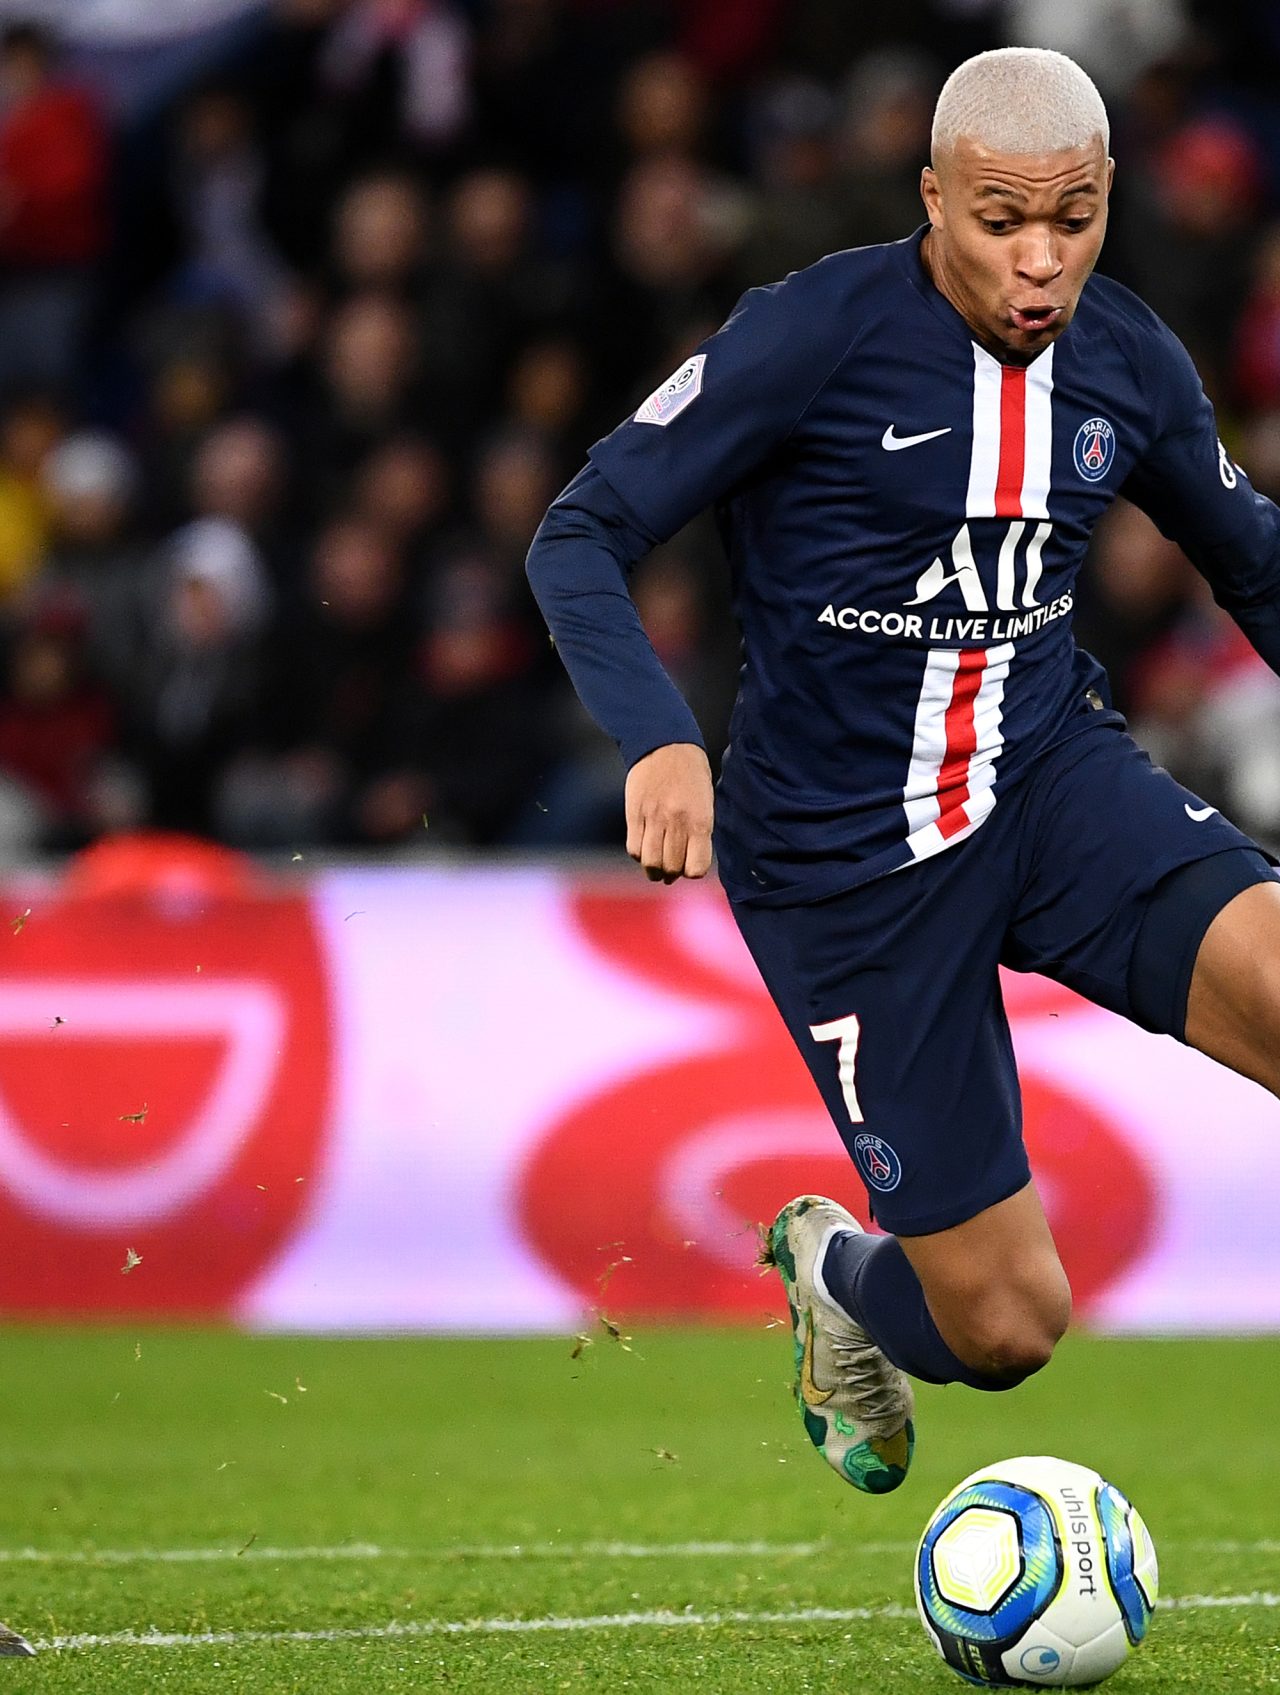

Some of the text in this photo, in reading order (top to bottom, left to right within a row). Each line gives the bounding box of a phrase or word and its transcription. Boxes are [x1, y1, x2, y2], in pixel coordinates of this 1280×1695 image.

[1083, 421, 1111, 439] PARIS
[817, 604, 923, 639] ACCOR
[929, 618, 988, 640] LIVE
[808, 1013, 864, 1123] 7
[857, 1136, 882, 1151] PARIS
[1060, 1487, 1097, 1596] uhlsport
